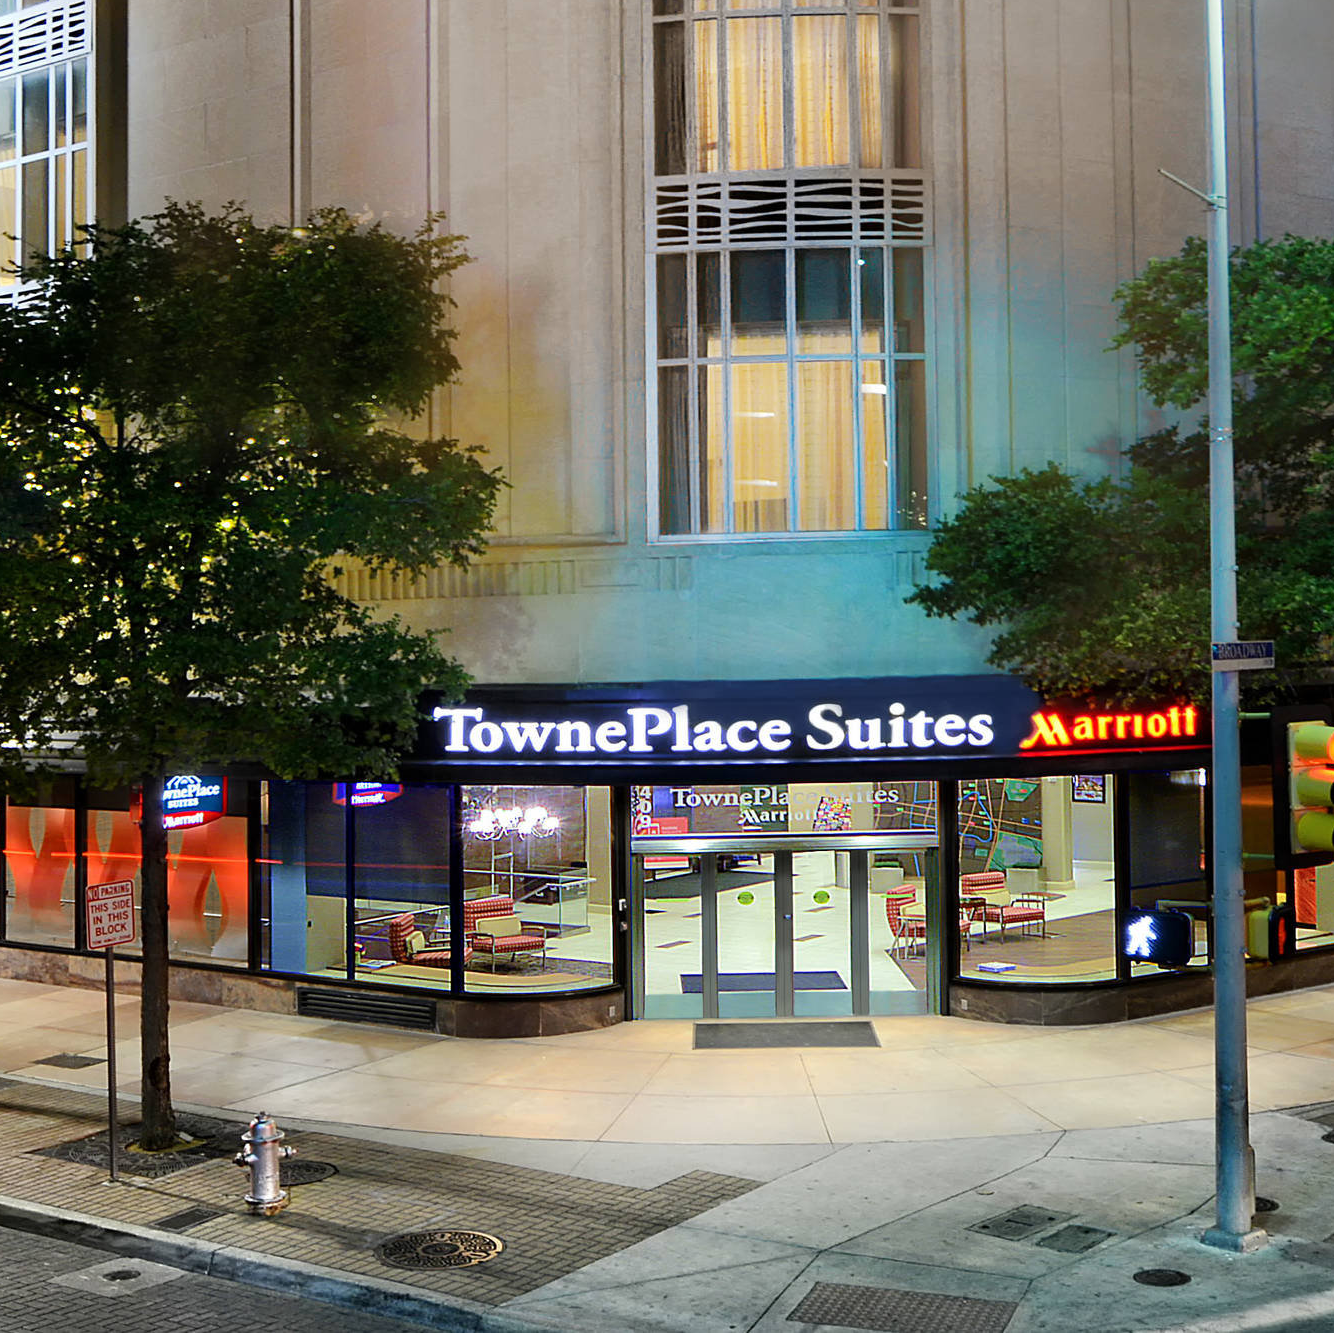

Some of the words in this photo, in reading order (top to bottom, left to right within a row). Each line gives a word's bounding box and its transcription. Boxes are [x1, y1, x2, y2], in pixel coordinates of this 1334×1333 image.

[1219, 643, 1266, 659] BROADWAY
[433, 704, 793, 753] TownePlace
[805, 702, 994, 750] Suites
[1018, 706, 1197, 749] Marriott
[163, 783, 220, 801] wnePlace
[670, 785, 817, 808] TownePlace
[90, 902, 109, 914] THIS
[112, 898, 131, 910] SIDE
[93, 916, 103, 925] IN
[108, 910, 129, 922] THIS
[95, 922, 127, 937] BLOCK
